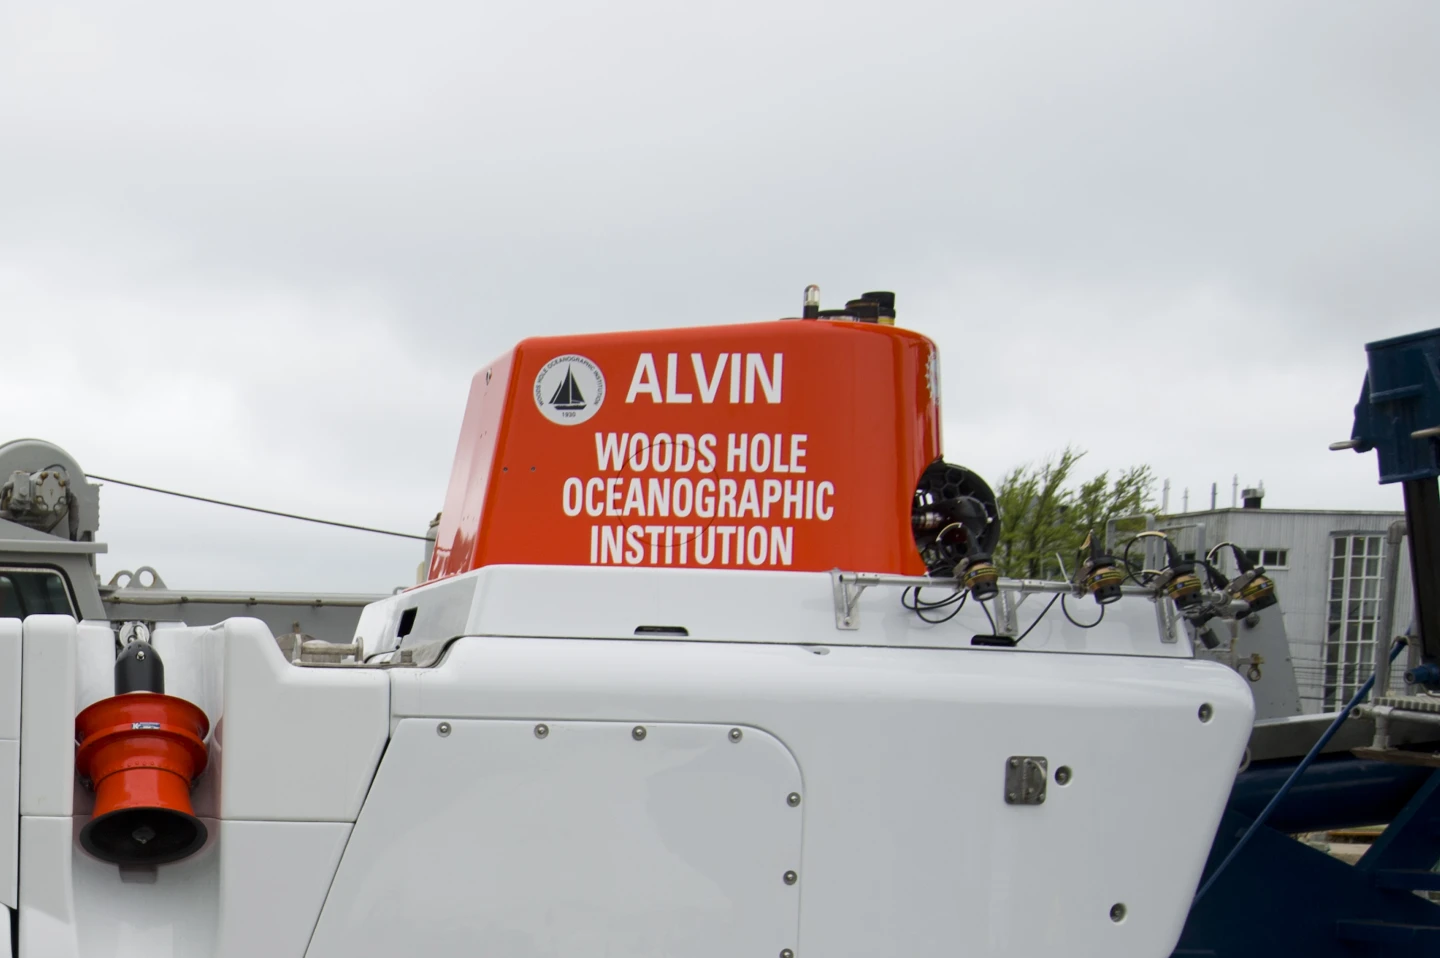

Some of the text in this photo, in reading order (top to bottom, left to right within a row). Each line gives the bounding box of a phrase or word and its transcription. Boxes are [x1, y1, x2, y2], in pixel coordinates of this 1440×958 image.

[535, 355, 604, 406] WOODS HOLE OCEANOGRAPHIC INSTITUTION
[626, 352, 783, 404] ALVIN
[595, 431, 808, 474] WOODS HOLE
[562, 476, 835, 521] OCEANOGRAPHIC
[590, 524, 794, 566] INSTITUTION
